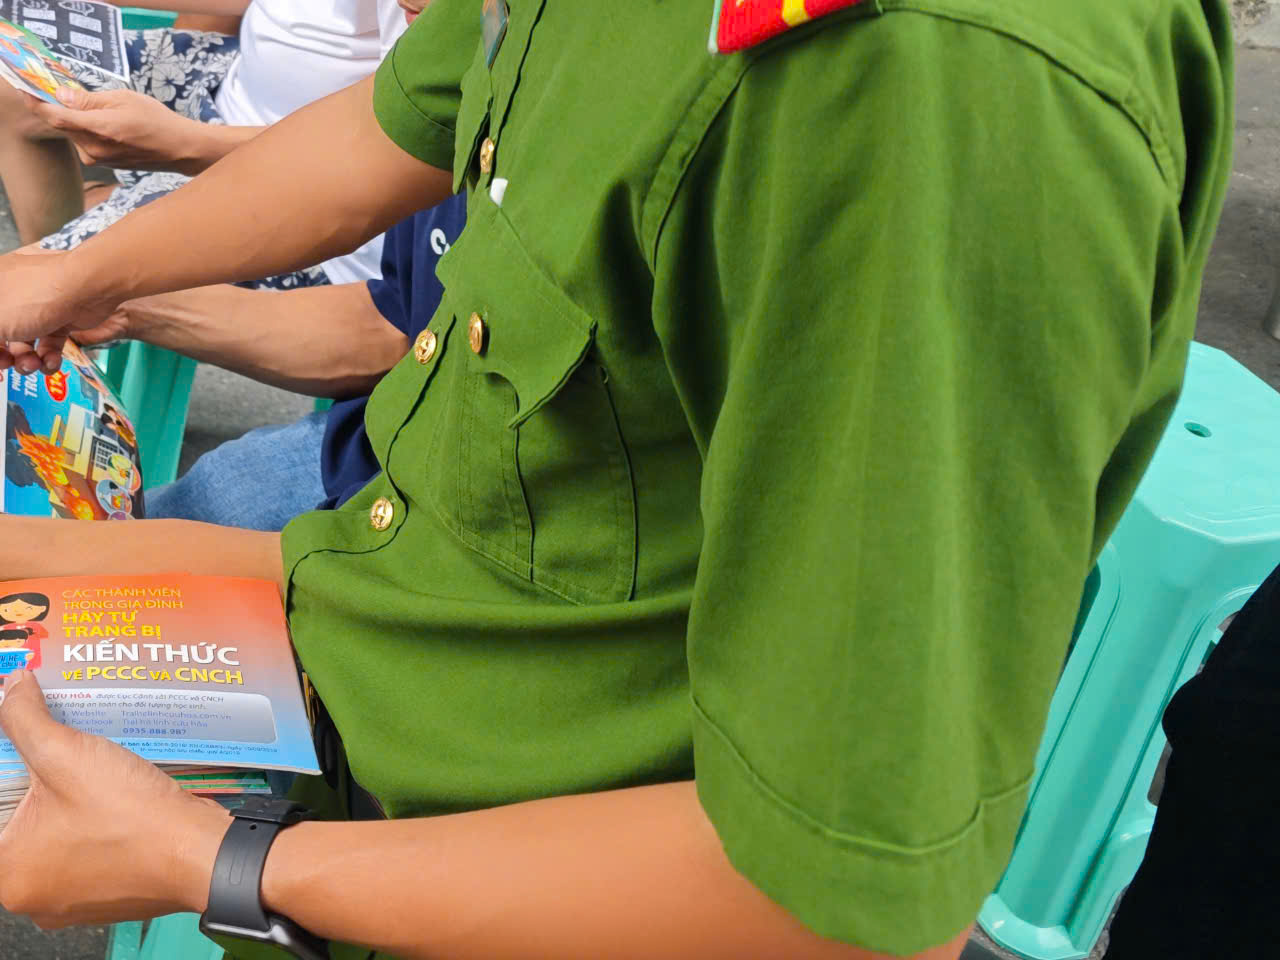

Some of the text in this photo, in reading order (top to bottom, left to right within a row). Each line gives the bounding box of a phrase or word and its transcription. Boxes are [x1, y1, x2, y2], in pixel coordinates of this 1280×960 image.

[148, 586, 181, 598] VIÊN
[64, 598, 183, 609] TRONG GIA ĐÌNH
[63, 609, 140, 626] HÃY TỰ
[62, 624, 161, 640] TRANG BỊ
[63, 638, 240, 666] KIẾN THỨC
[86, 666, 147, 680] PCCC
[175, 668, 244, 685] CNCH
